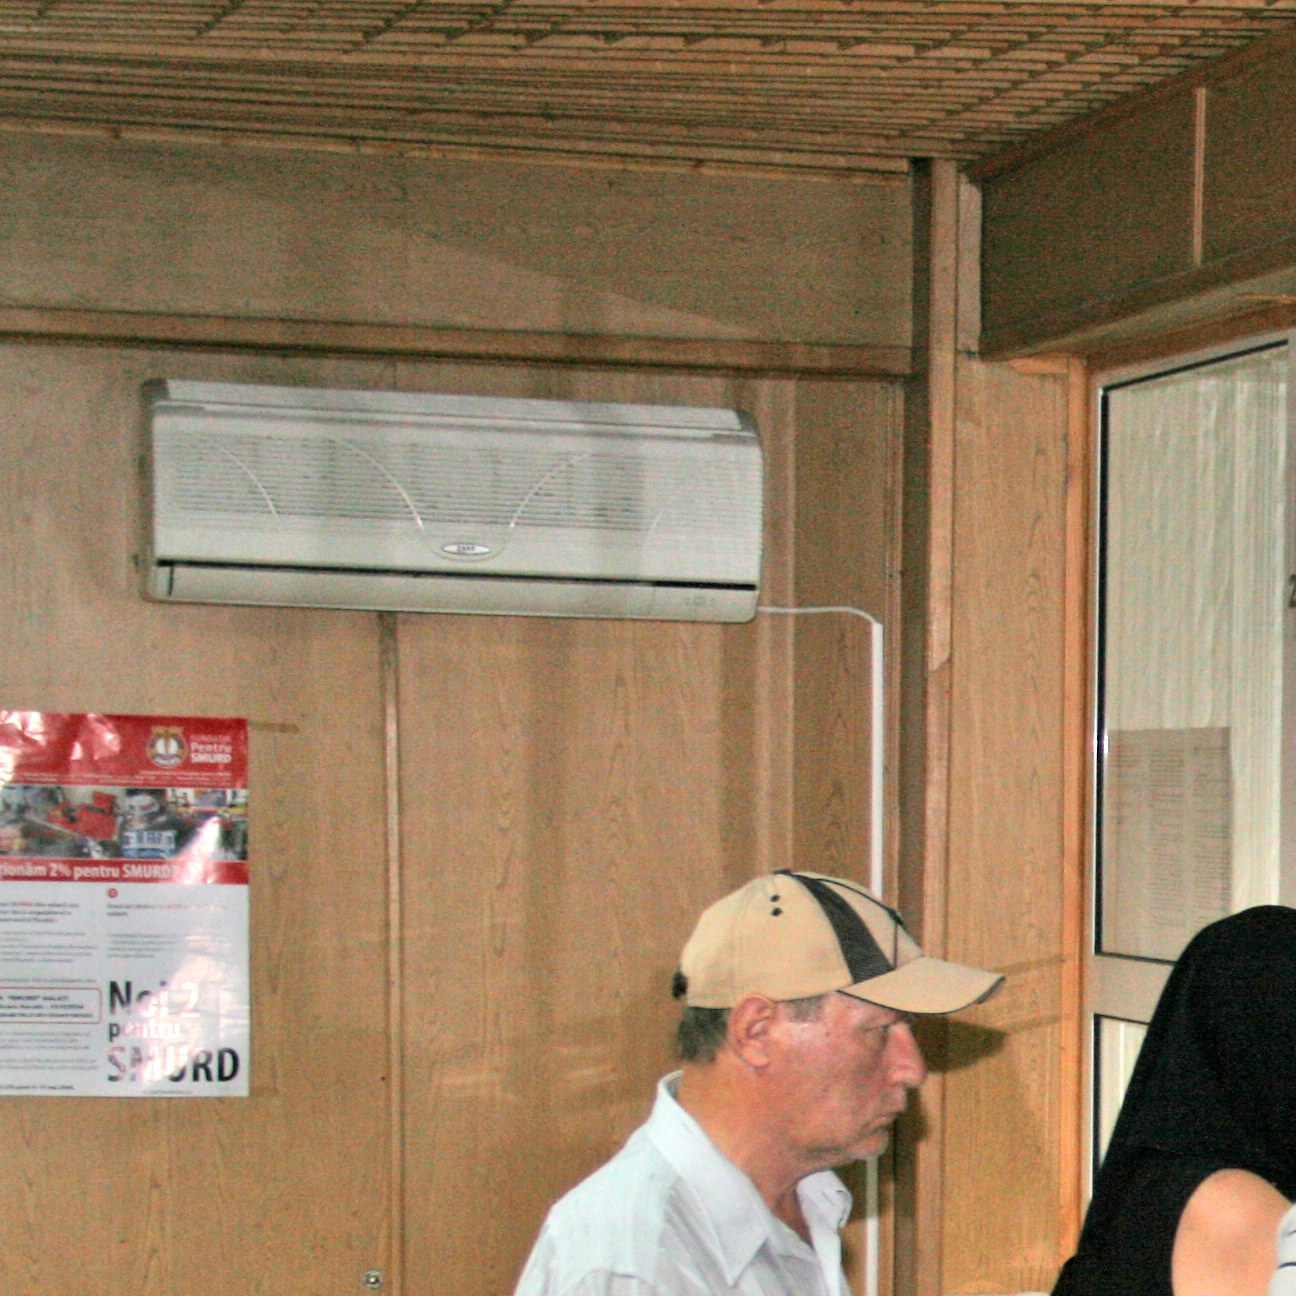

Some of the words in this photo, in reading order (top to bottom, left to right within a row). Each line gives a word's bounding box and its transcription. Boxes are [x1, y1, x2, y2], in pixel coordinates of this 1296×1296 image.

[190, 742, 233, 754] Pentru
[190, 753, 233, 763] SMURD
[50, 863, 71, 878] 2%
[73, 866, 120, 880] pentru
[109, 979, 169, 1018] Noi
[108, 1020, 181, 1043] pentru
[107, 1045, 240, 1082] SMURD
